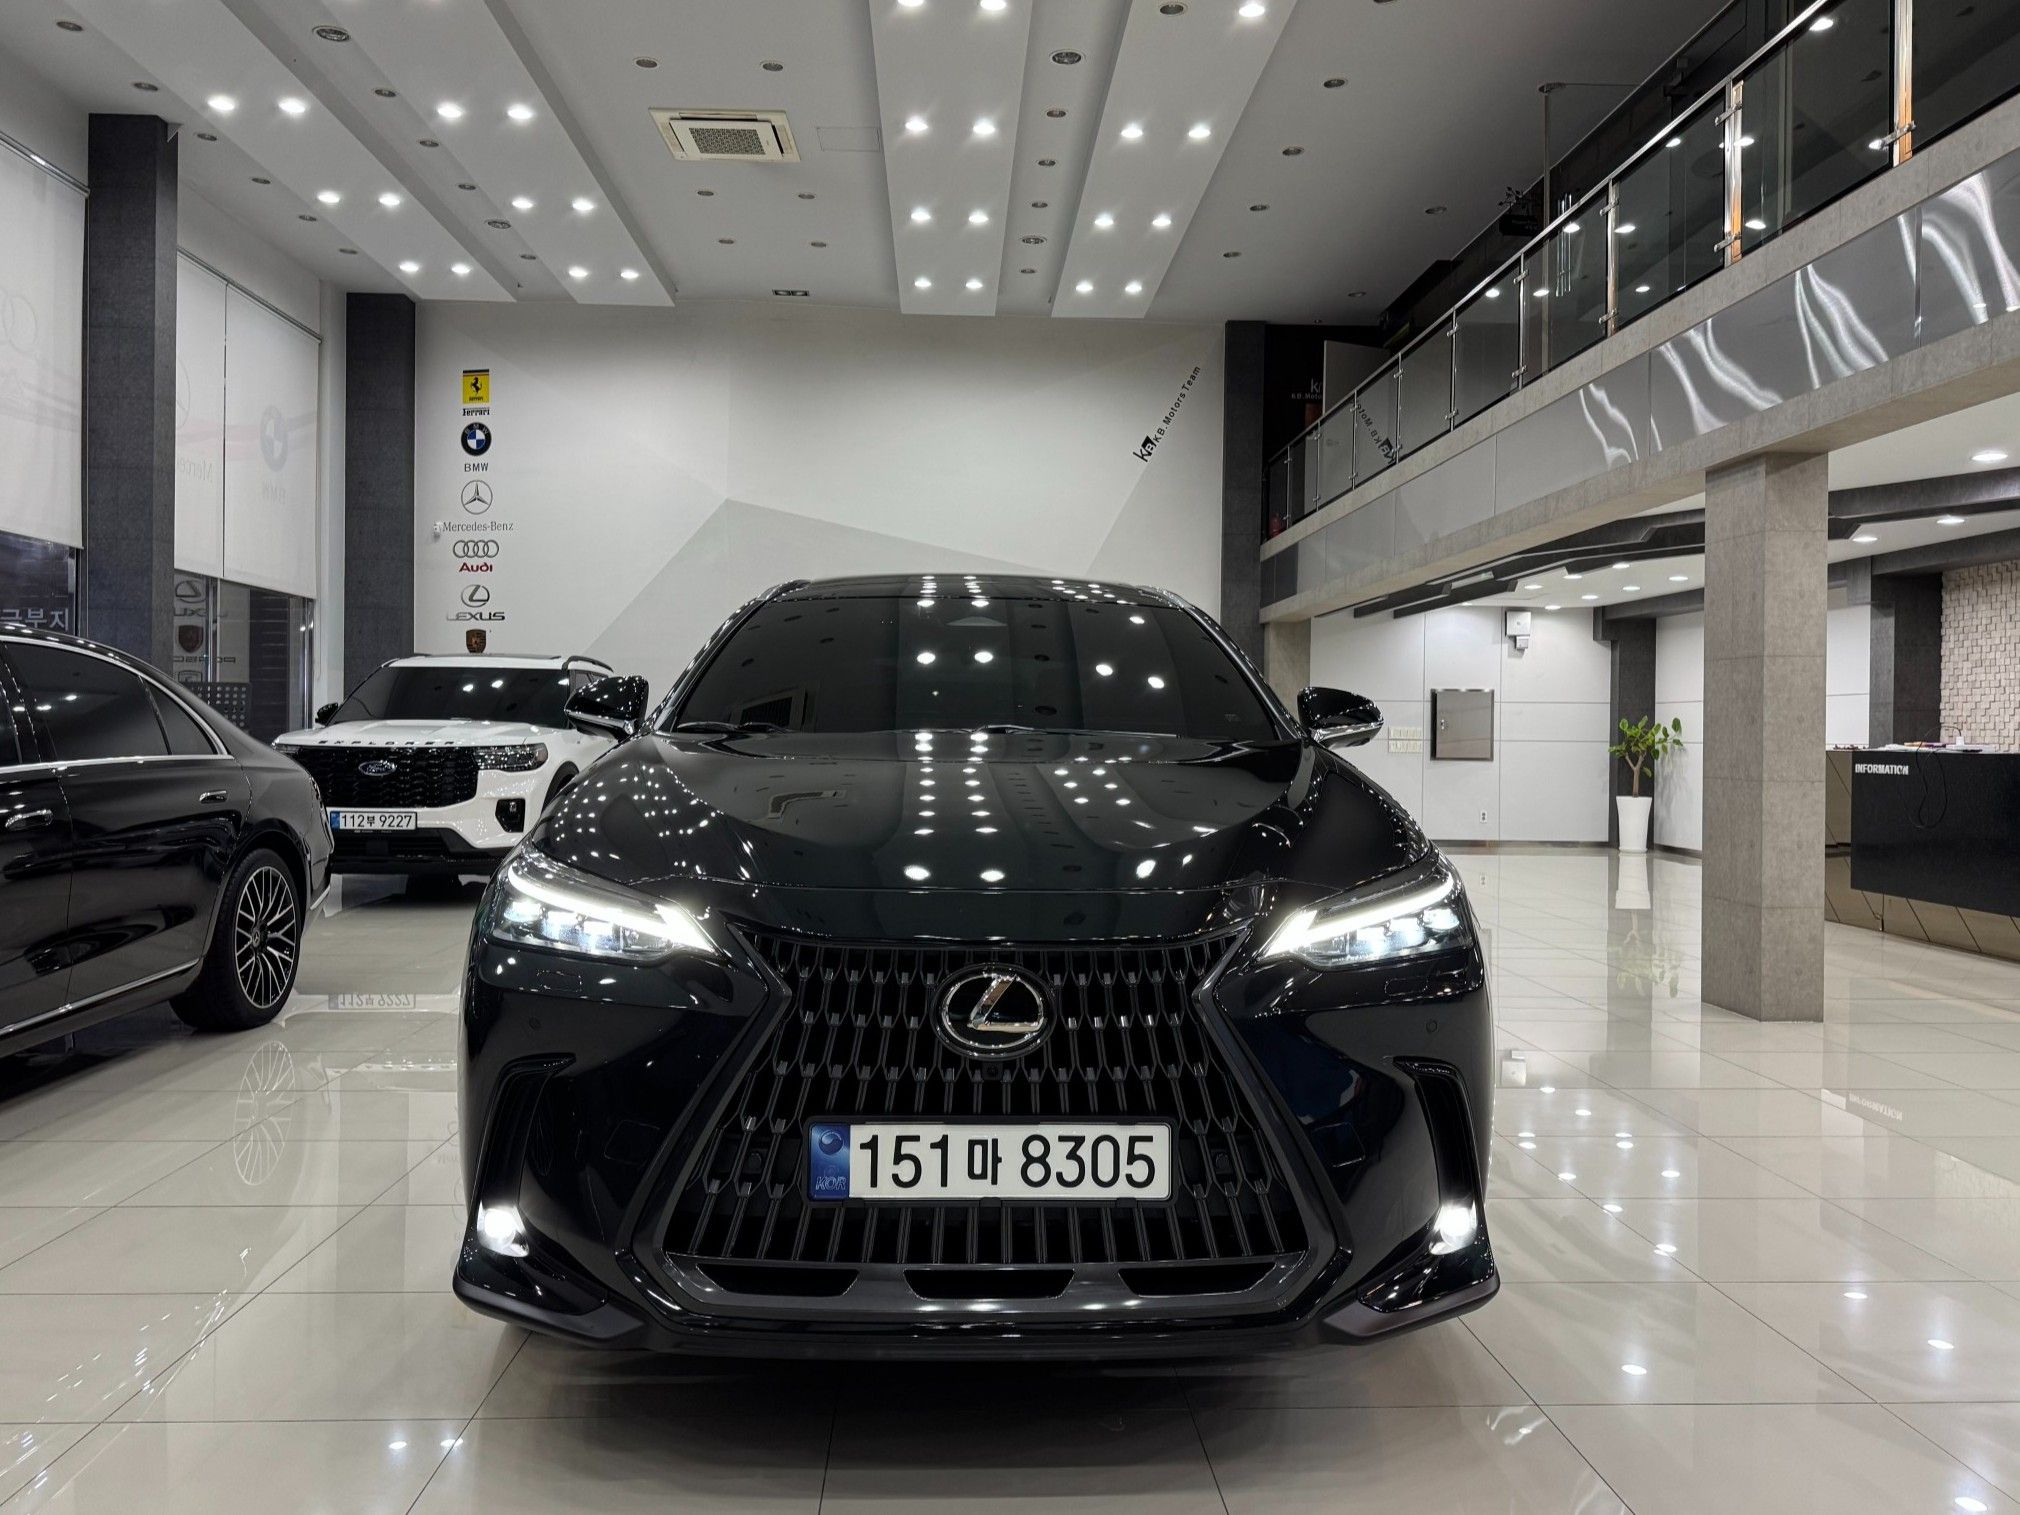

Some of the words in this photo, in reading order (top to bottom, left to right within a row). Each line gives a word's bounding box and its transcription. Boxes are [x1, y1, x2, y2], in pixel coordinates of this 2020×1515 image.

[1181, 366, 1201, 391] Team
[462, 407, 490, 416] Ferrari
[464, 462, 489, 472] BMW
[443, 521, 514, 532] Mercedes-Benz
[459, 562, 493, 572] Audi
[446, 611, 506, 621] LEXUS
[1855, 763, 1909, 776] INFORMATION
[341, 814, 375, 828] 112부
[379, 814, 412, 828] 9227
[859, 1133, 1003, 1189] 151마
[1020, 1133, 1156, 1189] 8305
[815, 1176, 848, 1191] KOR
